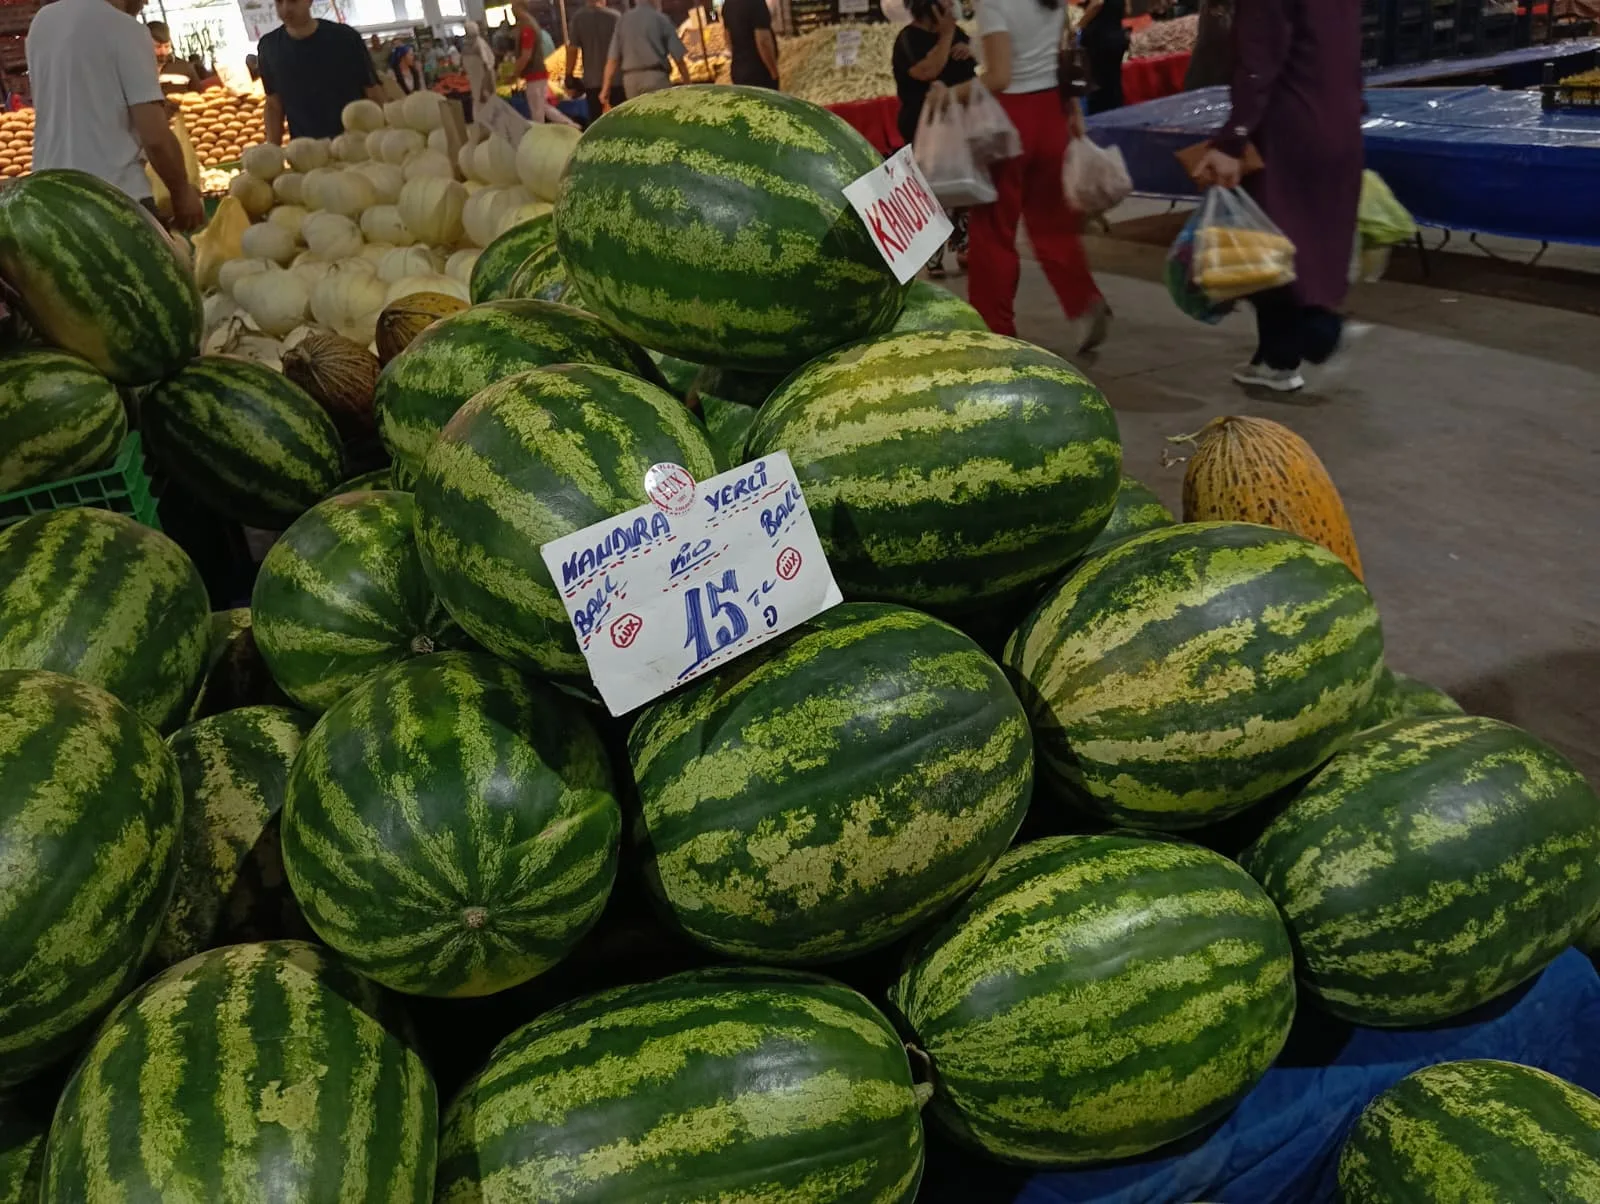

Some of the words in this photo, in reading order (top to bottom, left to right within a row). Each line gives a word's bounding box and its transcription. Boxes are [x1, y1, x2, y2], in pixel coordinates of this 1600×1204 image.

[562, 511, 671, 587] KANDIRA
[704, 460, 767, 512] YERLİ
[782, 552, 798, 577] LÜX
[617, 618, 639, 645] LÜX
[683, 568, 749, 663] 15
